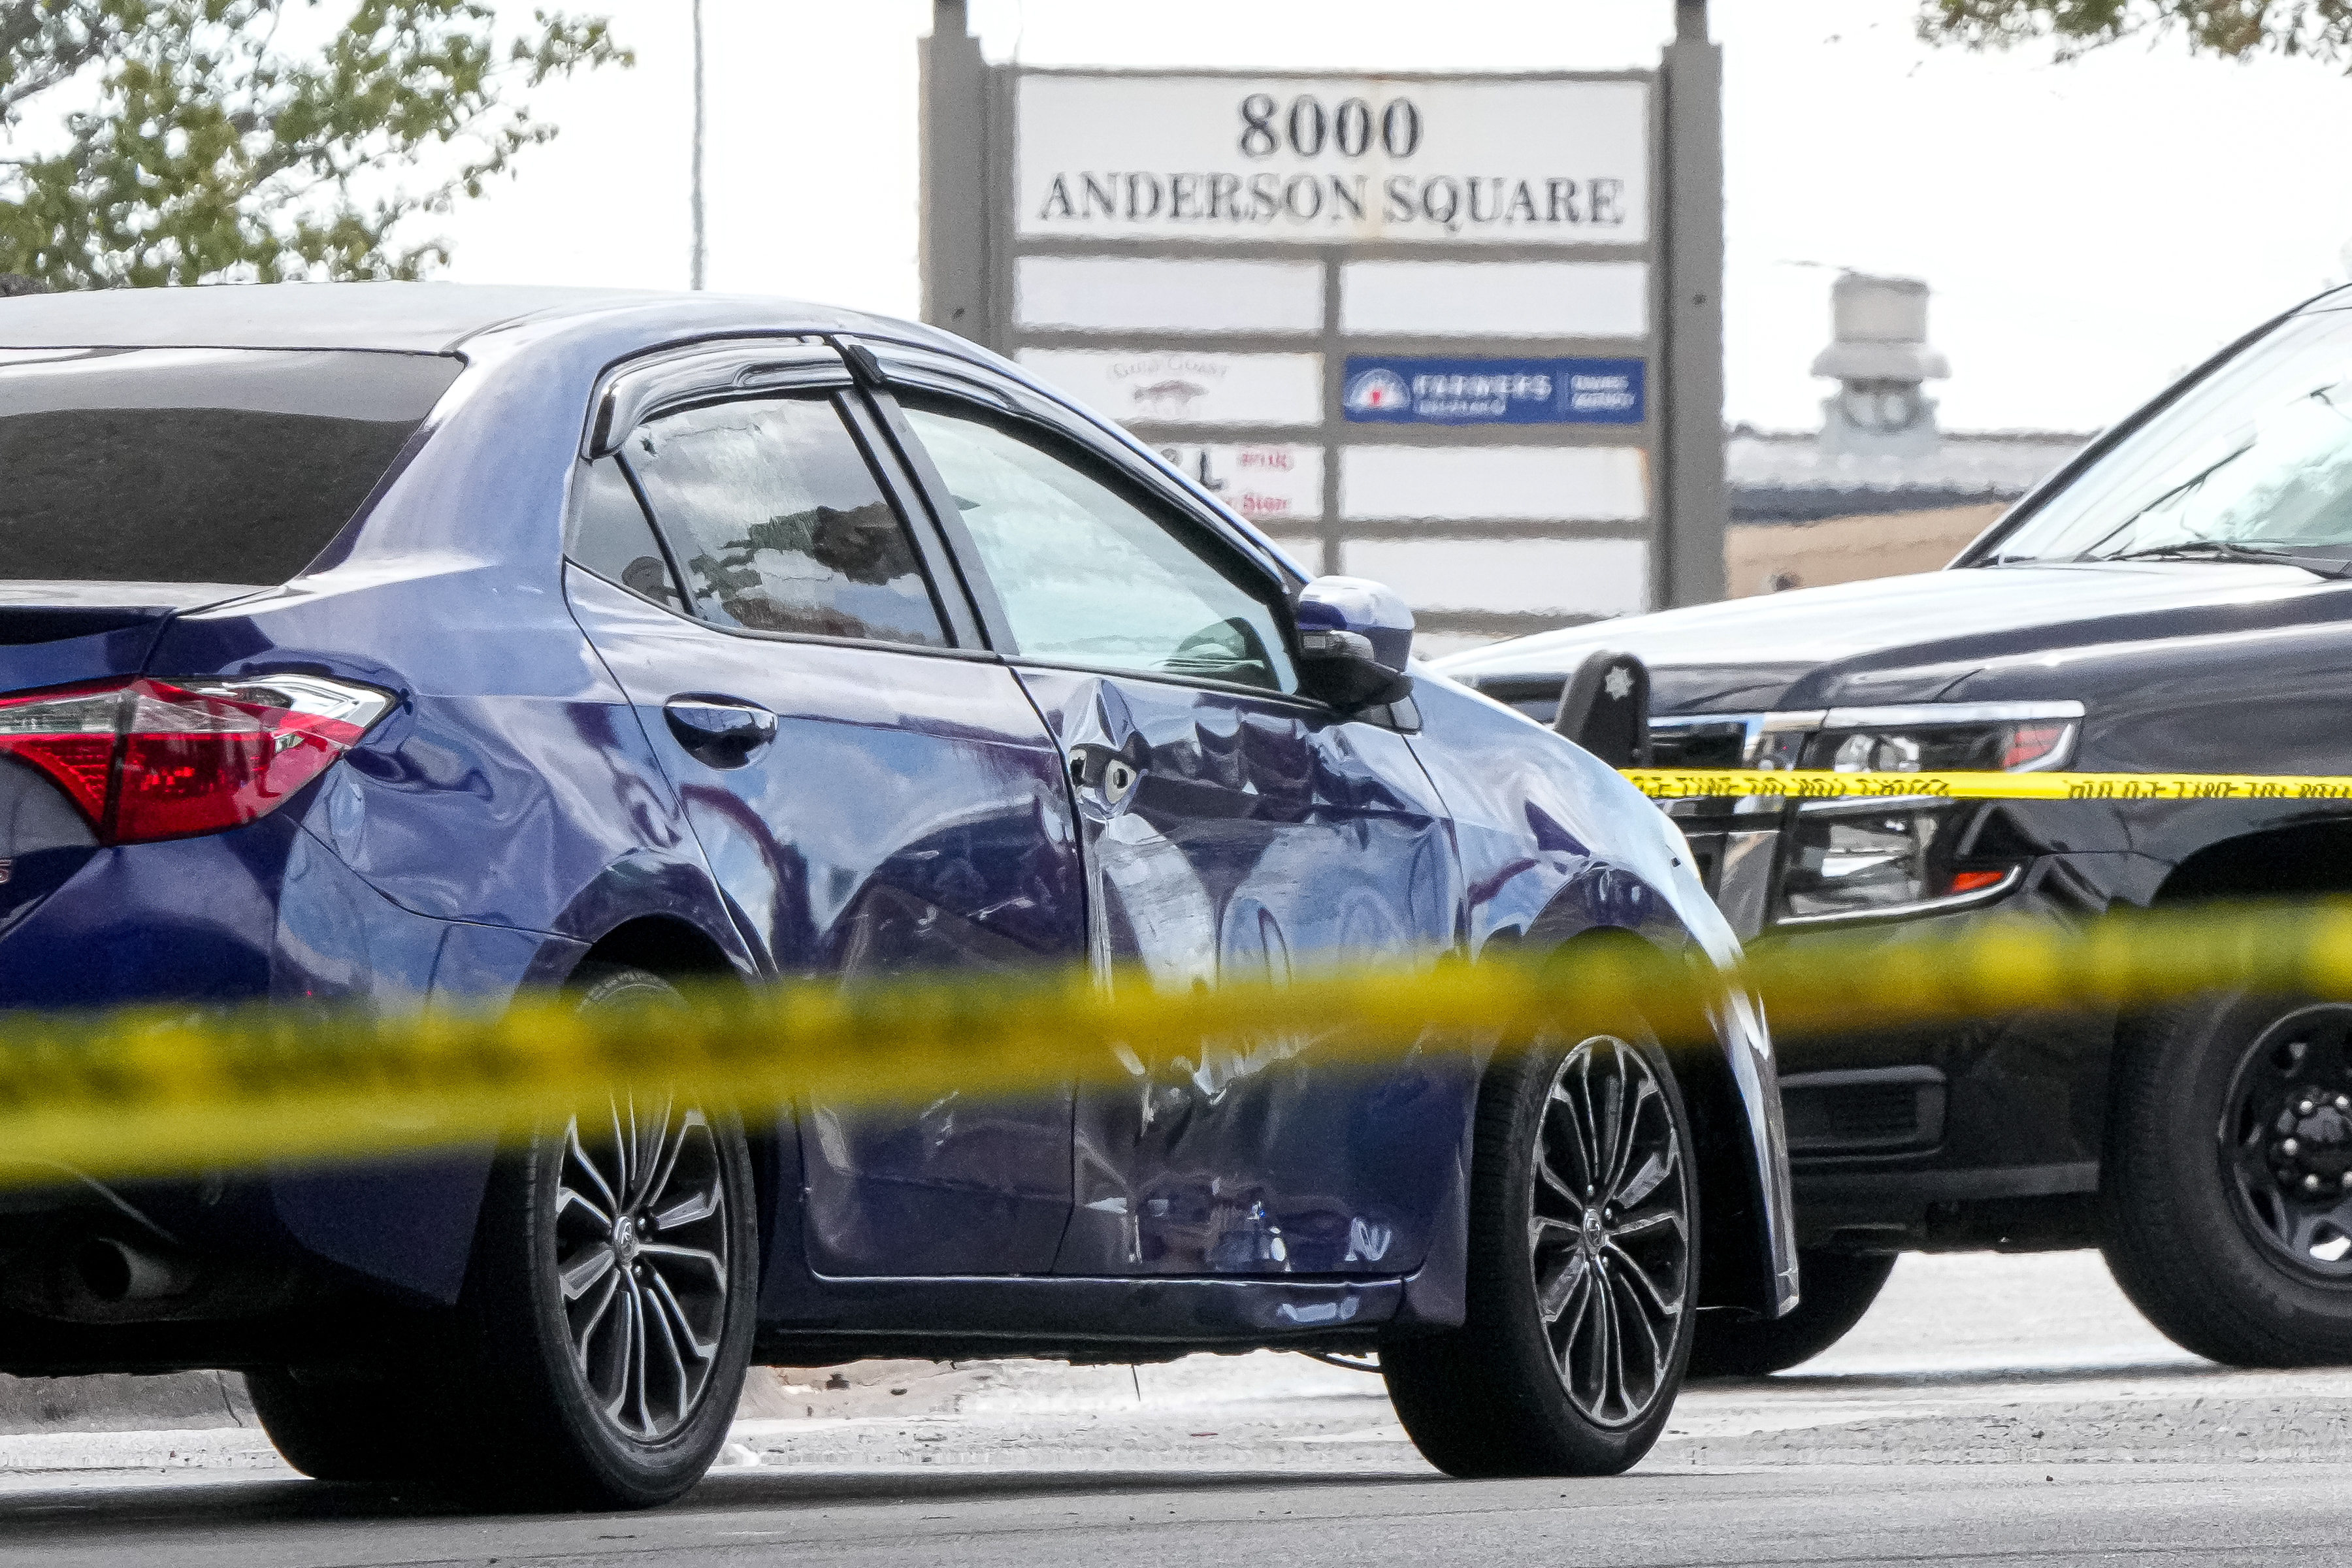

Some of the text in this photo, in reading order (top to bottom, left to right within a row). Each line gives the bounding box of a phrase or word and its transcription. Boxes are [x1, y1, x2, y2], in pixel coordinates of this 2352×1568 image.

[1237, 93, 1424, 159] 8000
[1040, 171, 1626, 233] ANDERSON SQUARE
